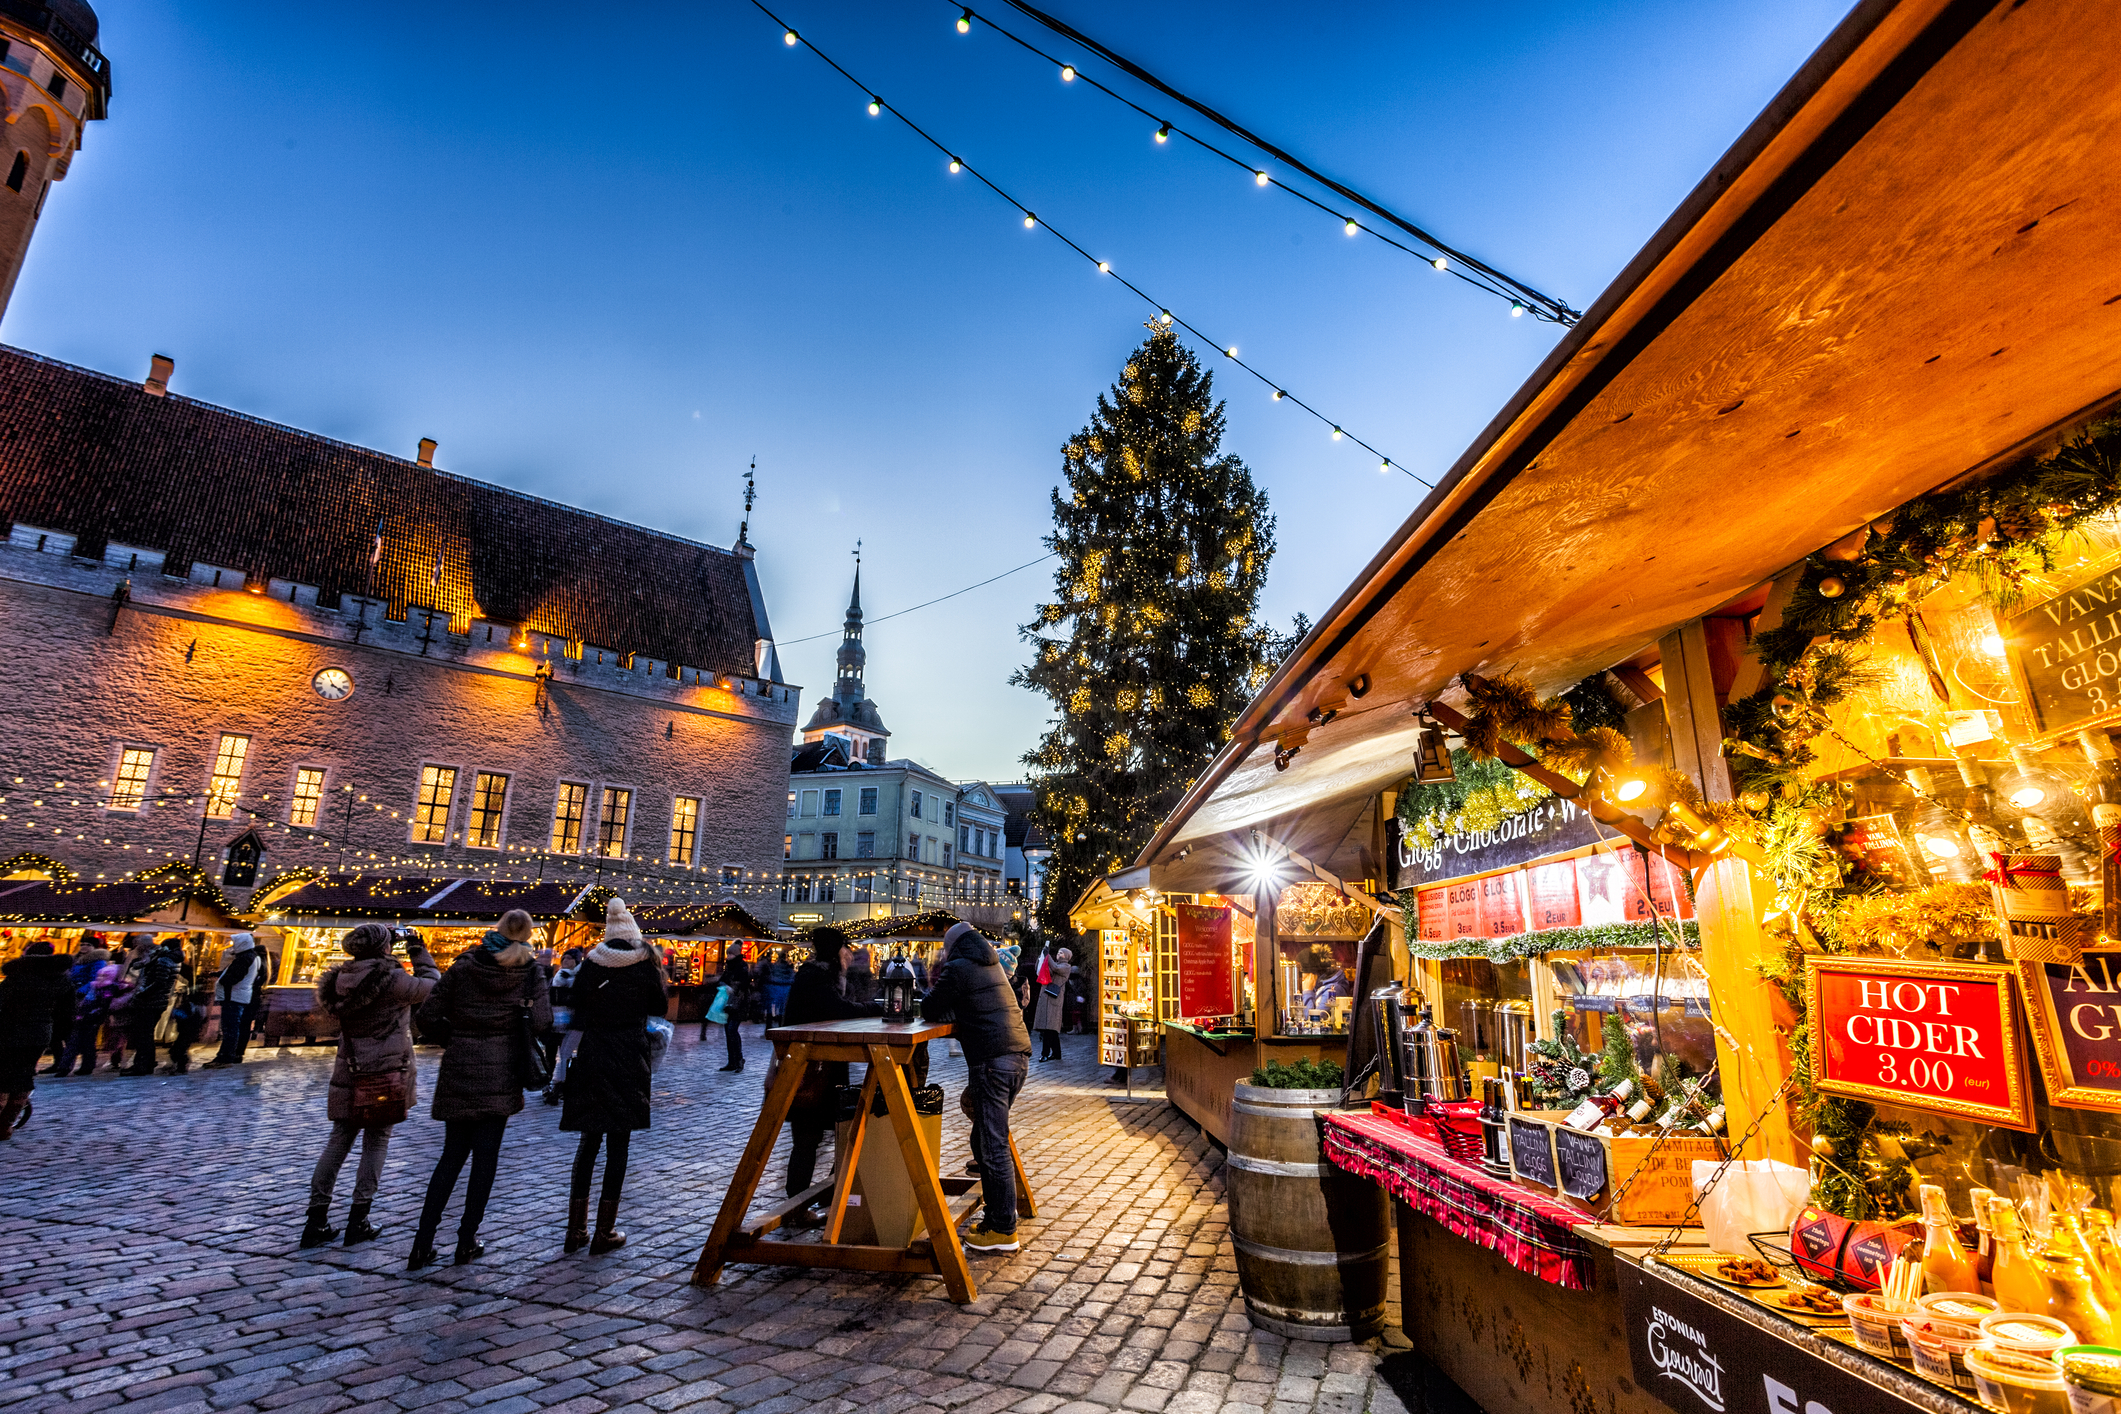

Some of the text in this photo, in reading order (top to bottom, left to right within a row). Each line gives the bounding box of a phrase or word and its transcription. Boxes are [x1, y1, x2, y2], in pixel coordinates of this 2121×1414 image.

[2033, 609, 2121, 669] TALLI
[2061, 647, 2121, 690] GLÖ
[1866, 831, 1886, 840] VANA
[1450, 886, 1476, 904] GLÖGG
[2063, 957, 2121, 994] Al
[1857, 979, 1959, 1016] HOT
[1846, 1014, 1985, 1059] CIDER
[1878, 1053, 1990, 1092] 3.00 (eur)
[2087, 1060, 2121, 1078] 0%
[1519, 1120, 1543, 1137] VANA
[1513, 1133, 1548, 1154] TALLINN
[1567, 1132, 1596, 1153] VANA
[1557, 1147, 1600, 1171] TALLINN
[1652, 1157, 1667, 1171] DE
[1675, 1157, 1693, 1171] BE
[1570, 1167, 1600, 1188] LIQUEUR
[1652, 1306, 1707, 1348] ESTONIAN
[1645, 1318, 1725, 1410] Gourmet
